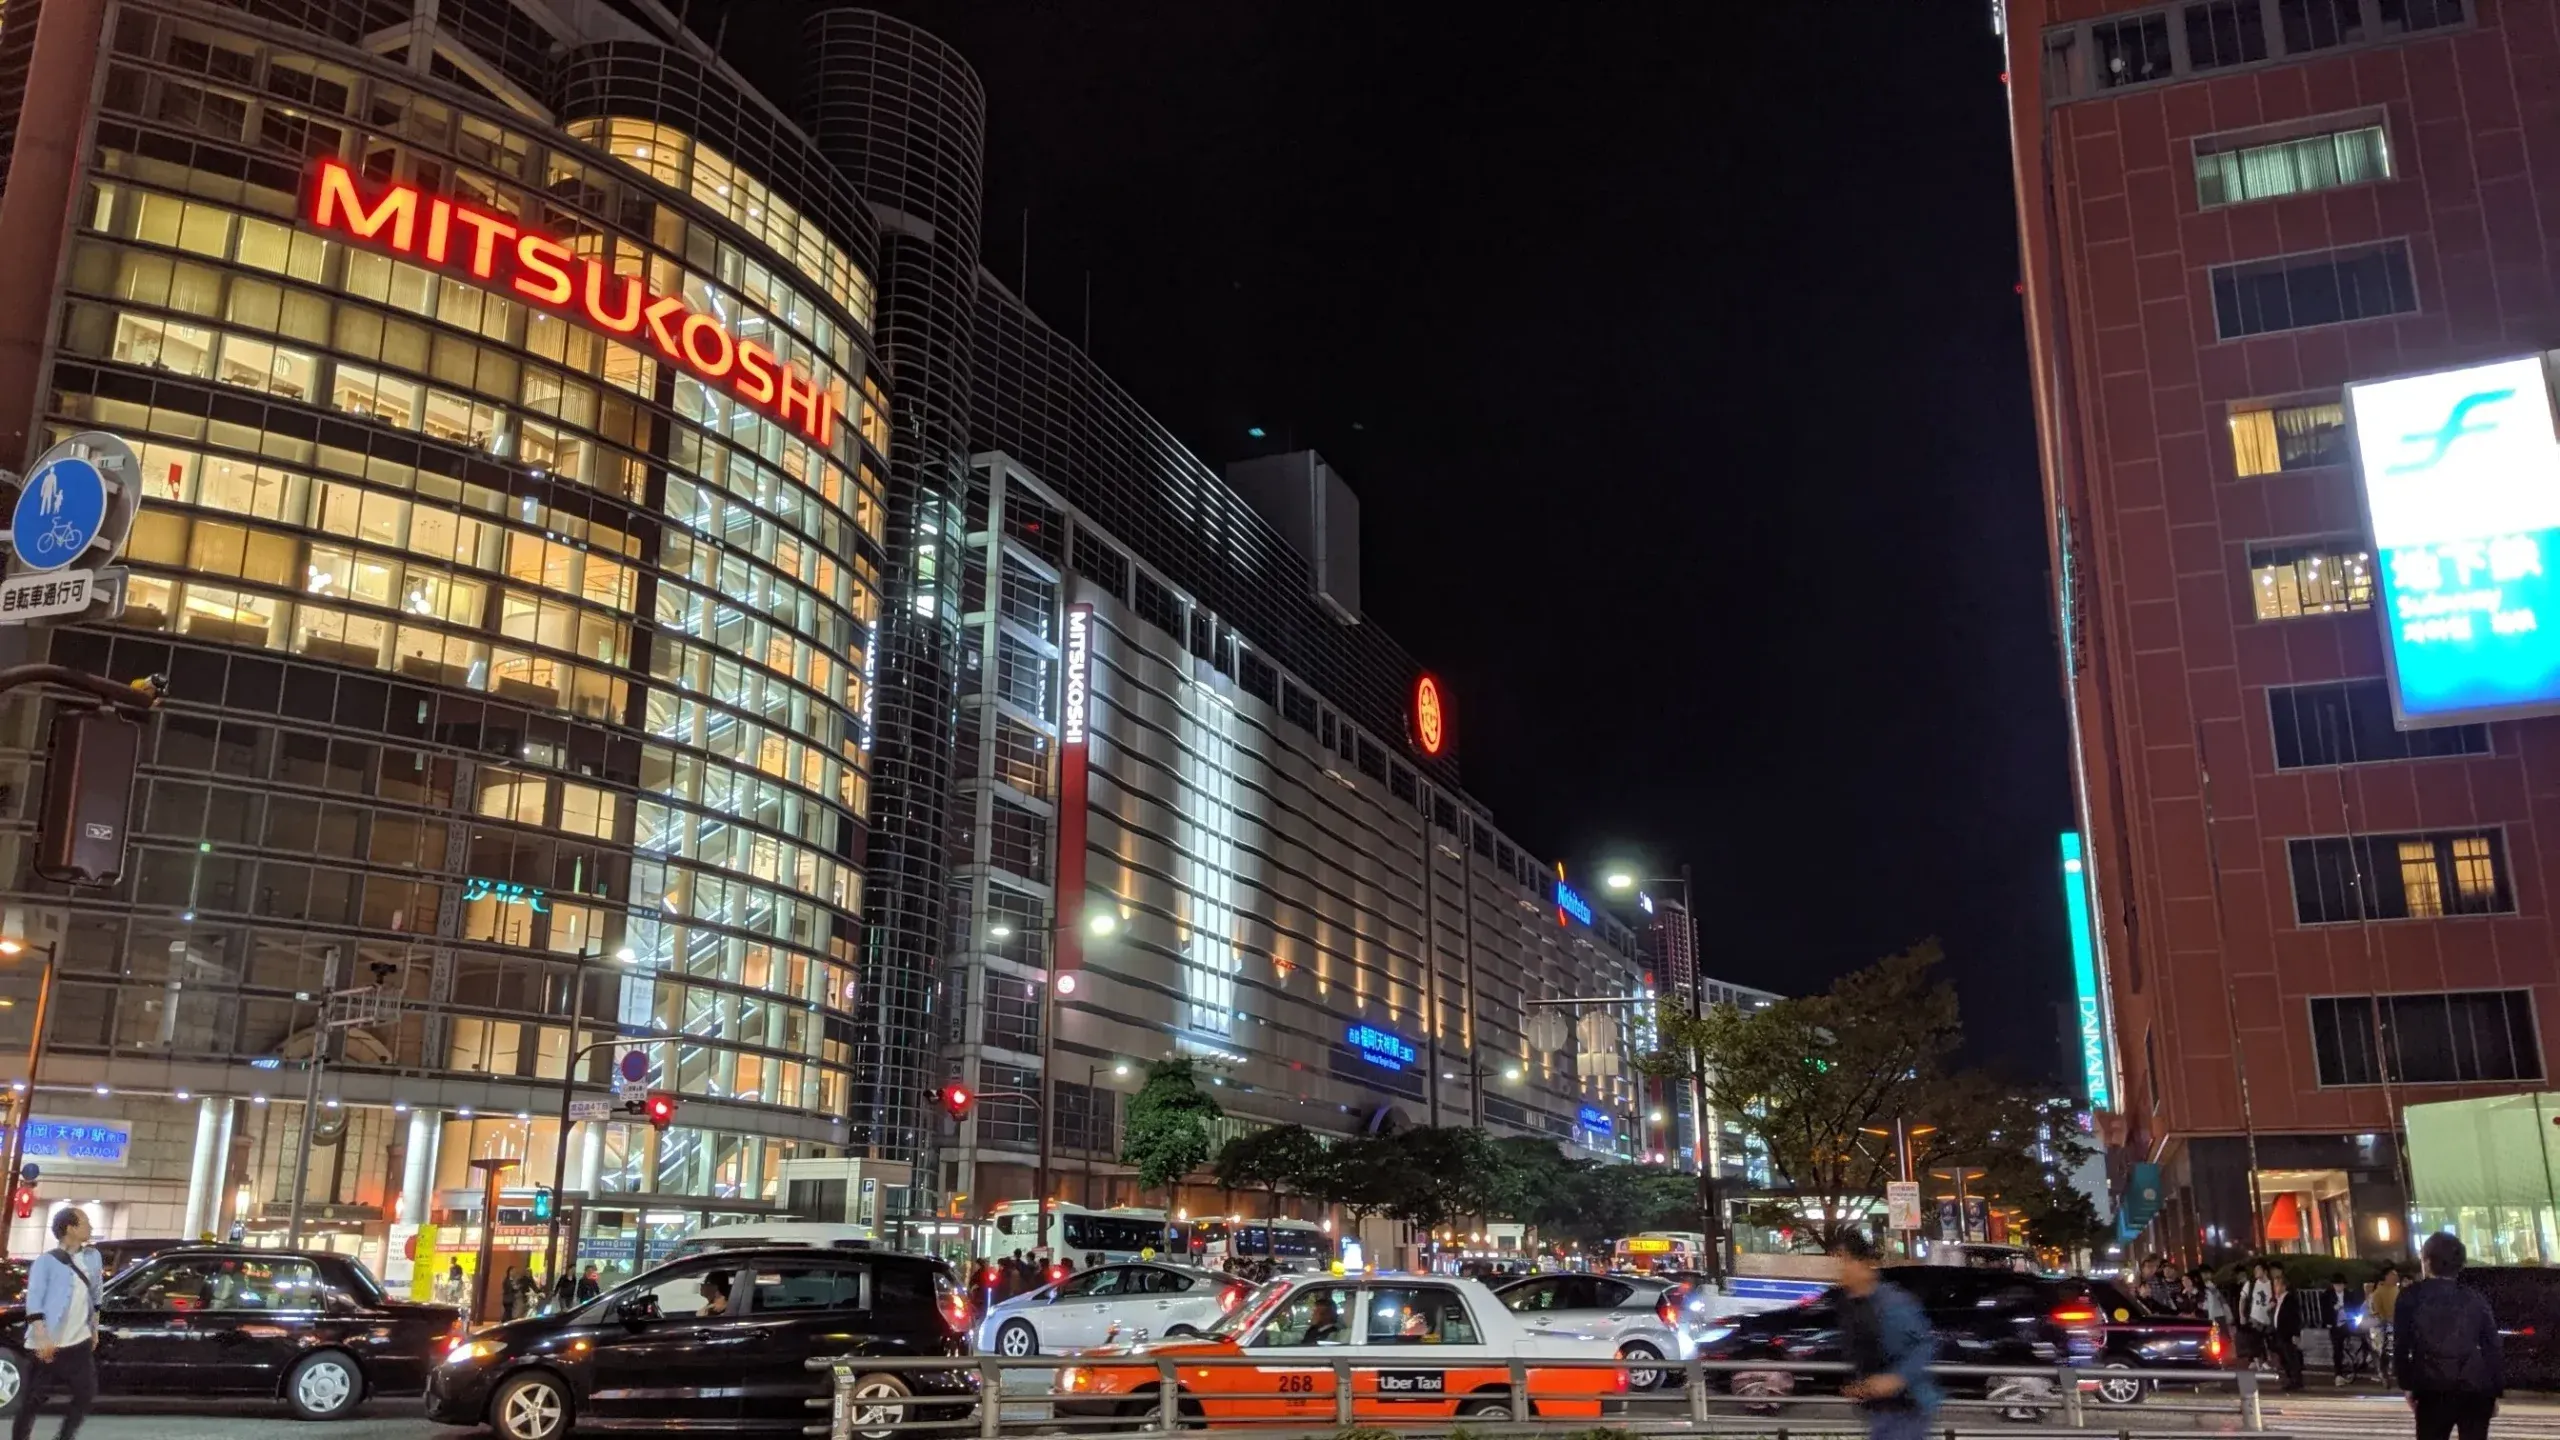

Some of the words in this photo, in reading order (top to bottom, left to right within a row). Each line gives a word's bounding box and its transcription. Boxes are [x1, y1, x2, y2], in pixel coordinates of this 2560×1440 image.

[315, 163, 832, 446] MITSUKOSHI
[2, 578, 87, 612] 自転車通行可
[1065, 611, 1087, 744] MITSUKOSHI
[1557, 880, 1592, 927] Nishitetsu
[1279, 1375, 1314, 1393] 268
[1380, 1376, 1413, 1390] Uber
[1416, 1376, 1442, 1390] Taxi
